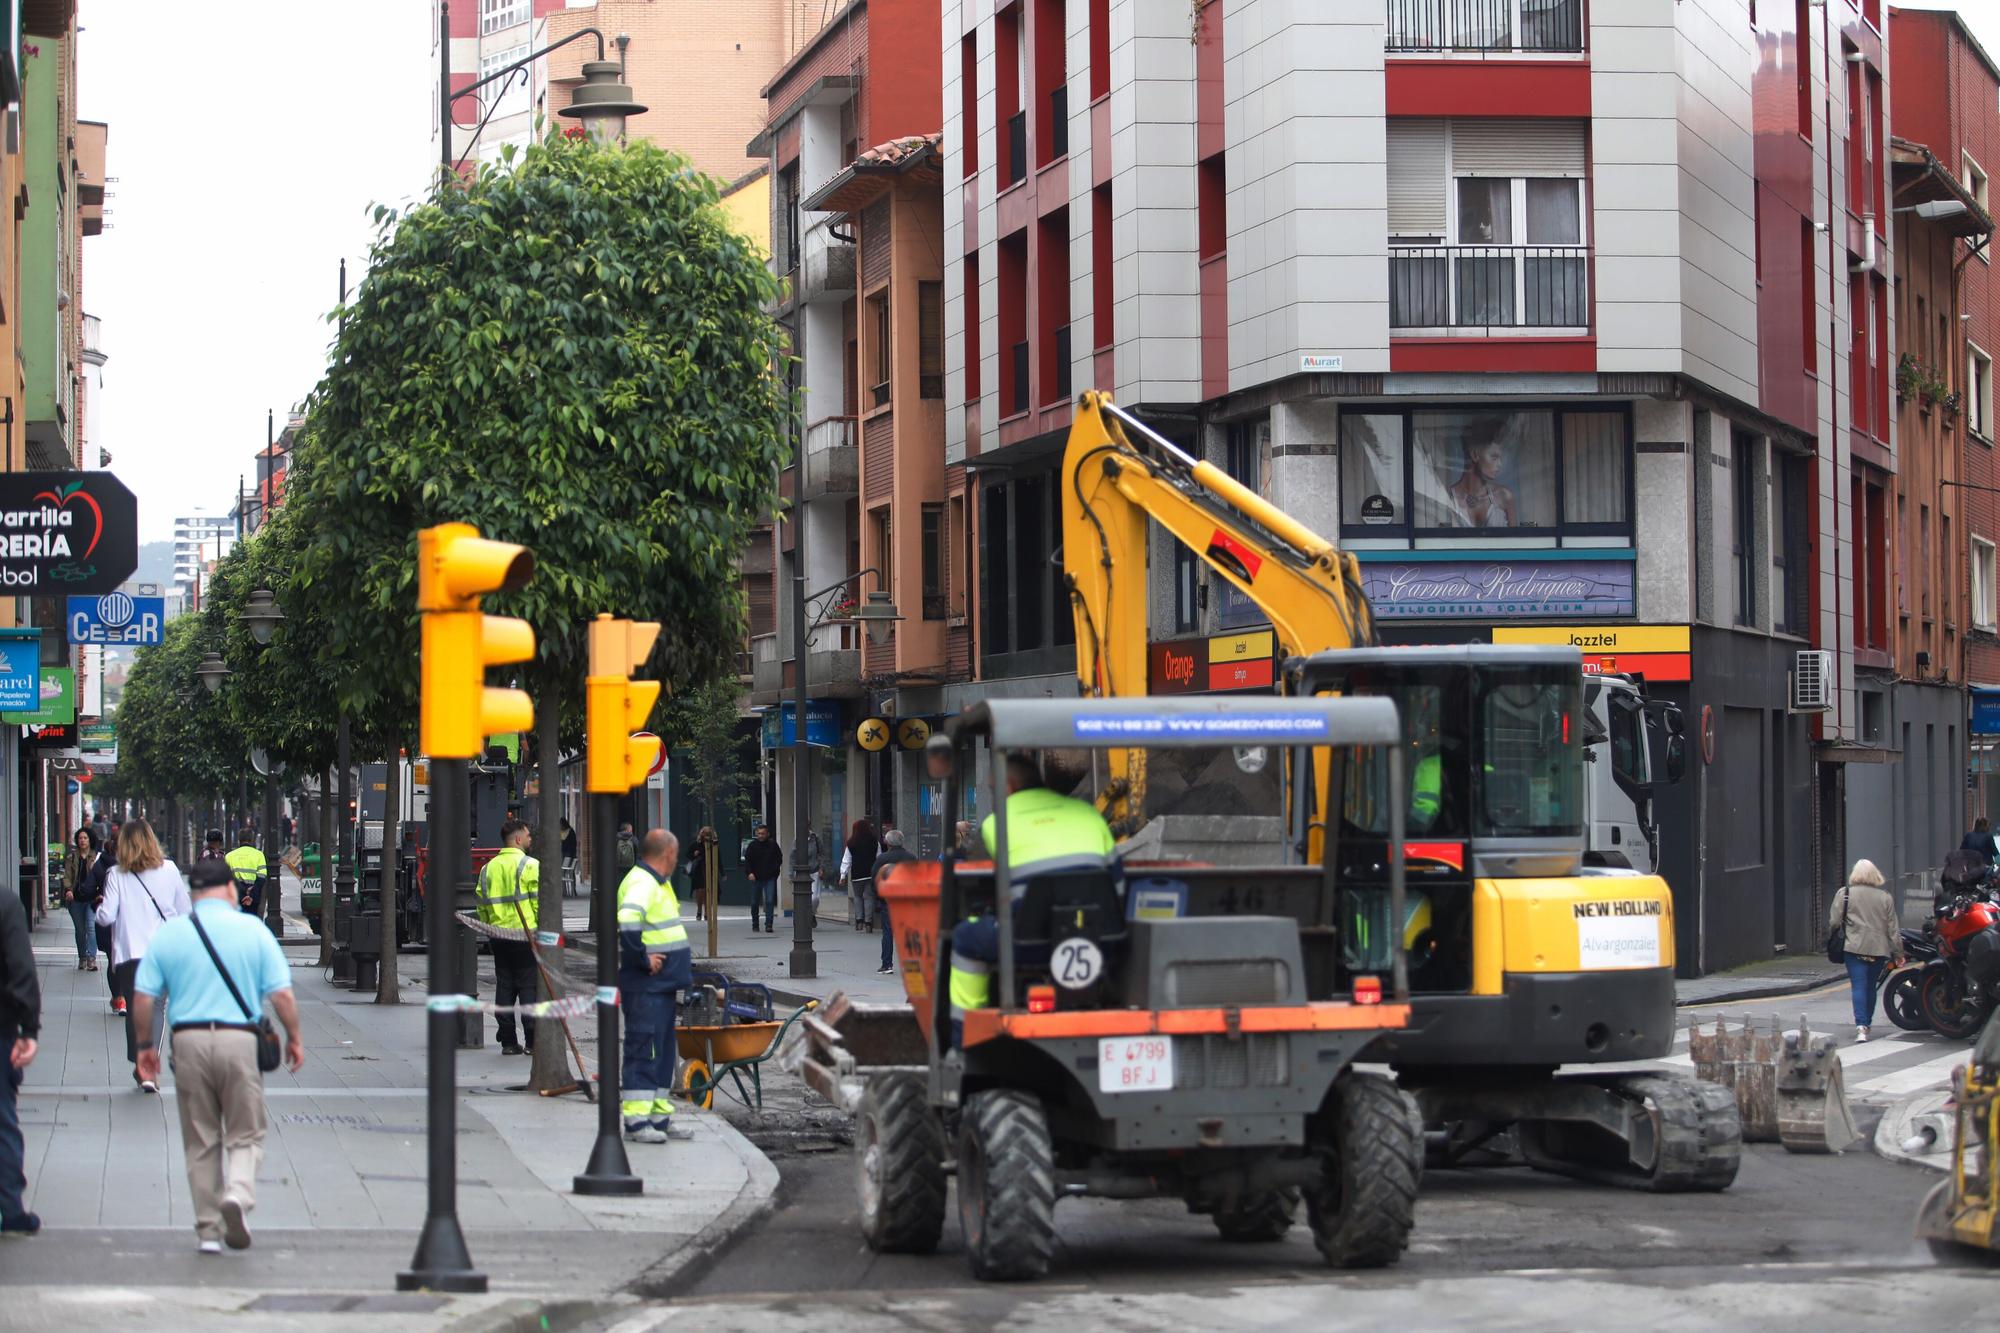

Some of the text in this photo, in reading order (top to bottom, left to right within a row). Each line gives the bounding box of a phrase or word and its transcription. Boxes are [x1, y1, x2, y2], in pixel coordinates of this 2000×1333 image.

[1303, 357, 1341, 367] Murart
[0, 505, 72, 527] arrilla
[0, 564, 37, 585] bol
[1389, 564, 1470, 604] Carmen
[1388, 602, 1584, 614] PELUQUERIA SOLARIUM
[1567, 633, 1617, 647] Jazztel
[1165, 650, 1194, 685] Orange
[38, 727, 64, 738] print
[1573, 900, 1661, 918] NEW HOLLAND
[1061, 944, 1092, 981] 25
